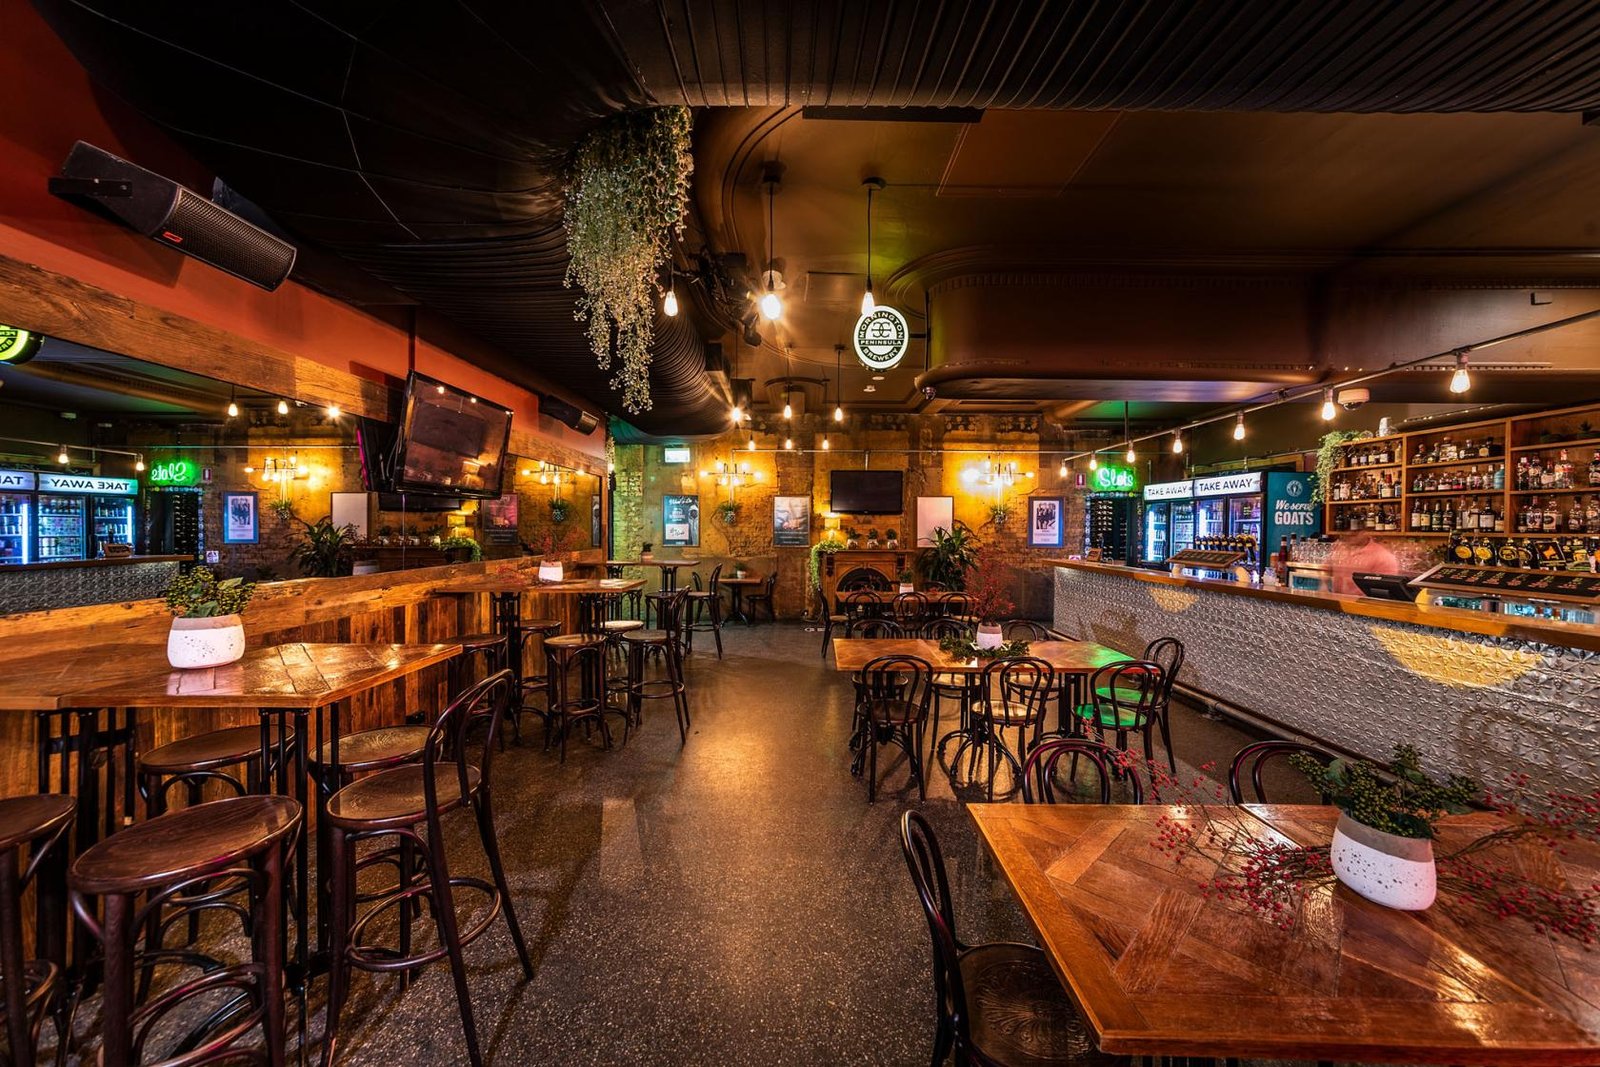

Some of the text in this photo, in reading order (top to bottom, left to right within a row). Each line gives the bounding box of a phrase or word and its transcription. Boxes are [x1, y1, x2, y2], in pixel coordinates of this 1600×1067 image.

[859, 312, 904, 339] MORNINGTON
[863, 348, 899, 361] BREWERY
[1099, 467, 1133, 487] Slots
[1148, 486, 1187, 496] TAKE AWAY
[1199, 478, 1253, 492] TAKE AWAY
[1275, 499, 1290, 510] We
[1274, 511, 1314, 525] GOATS
